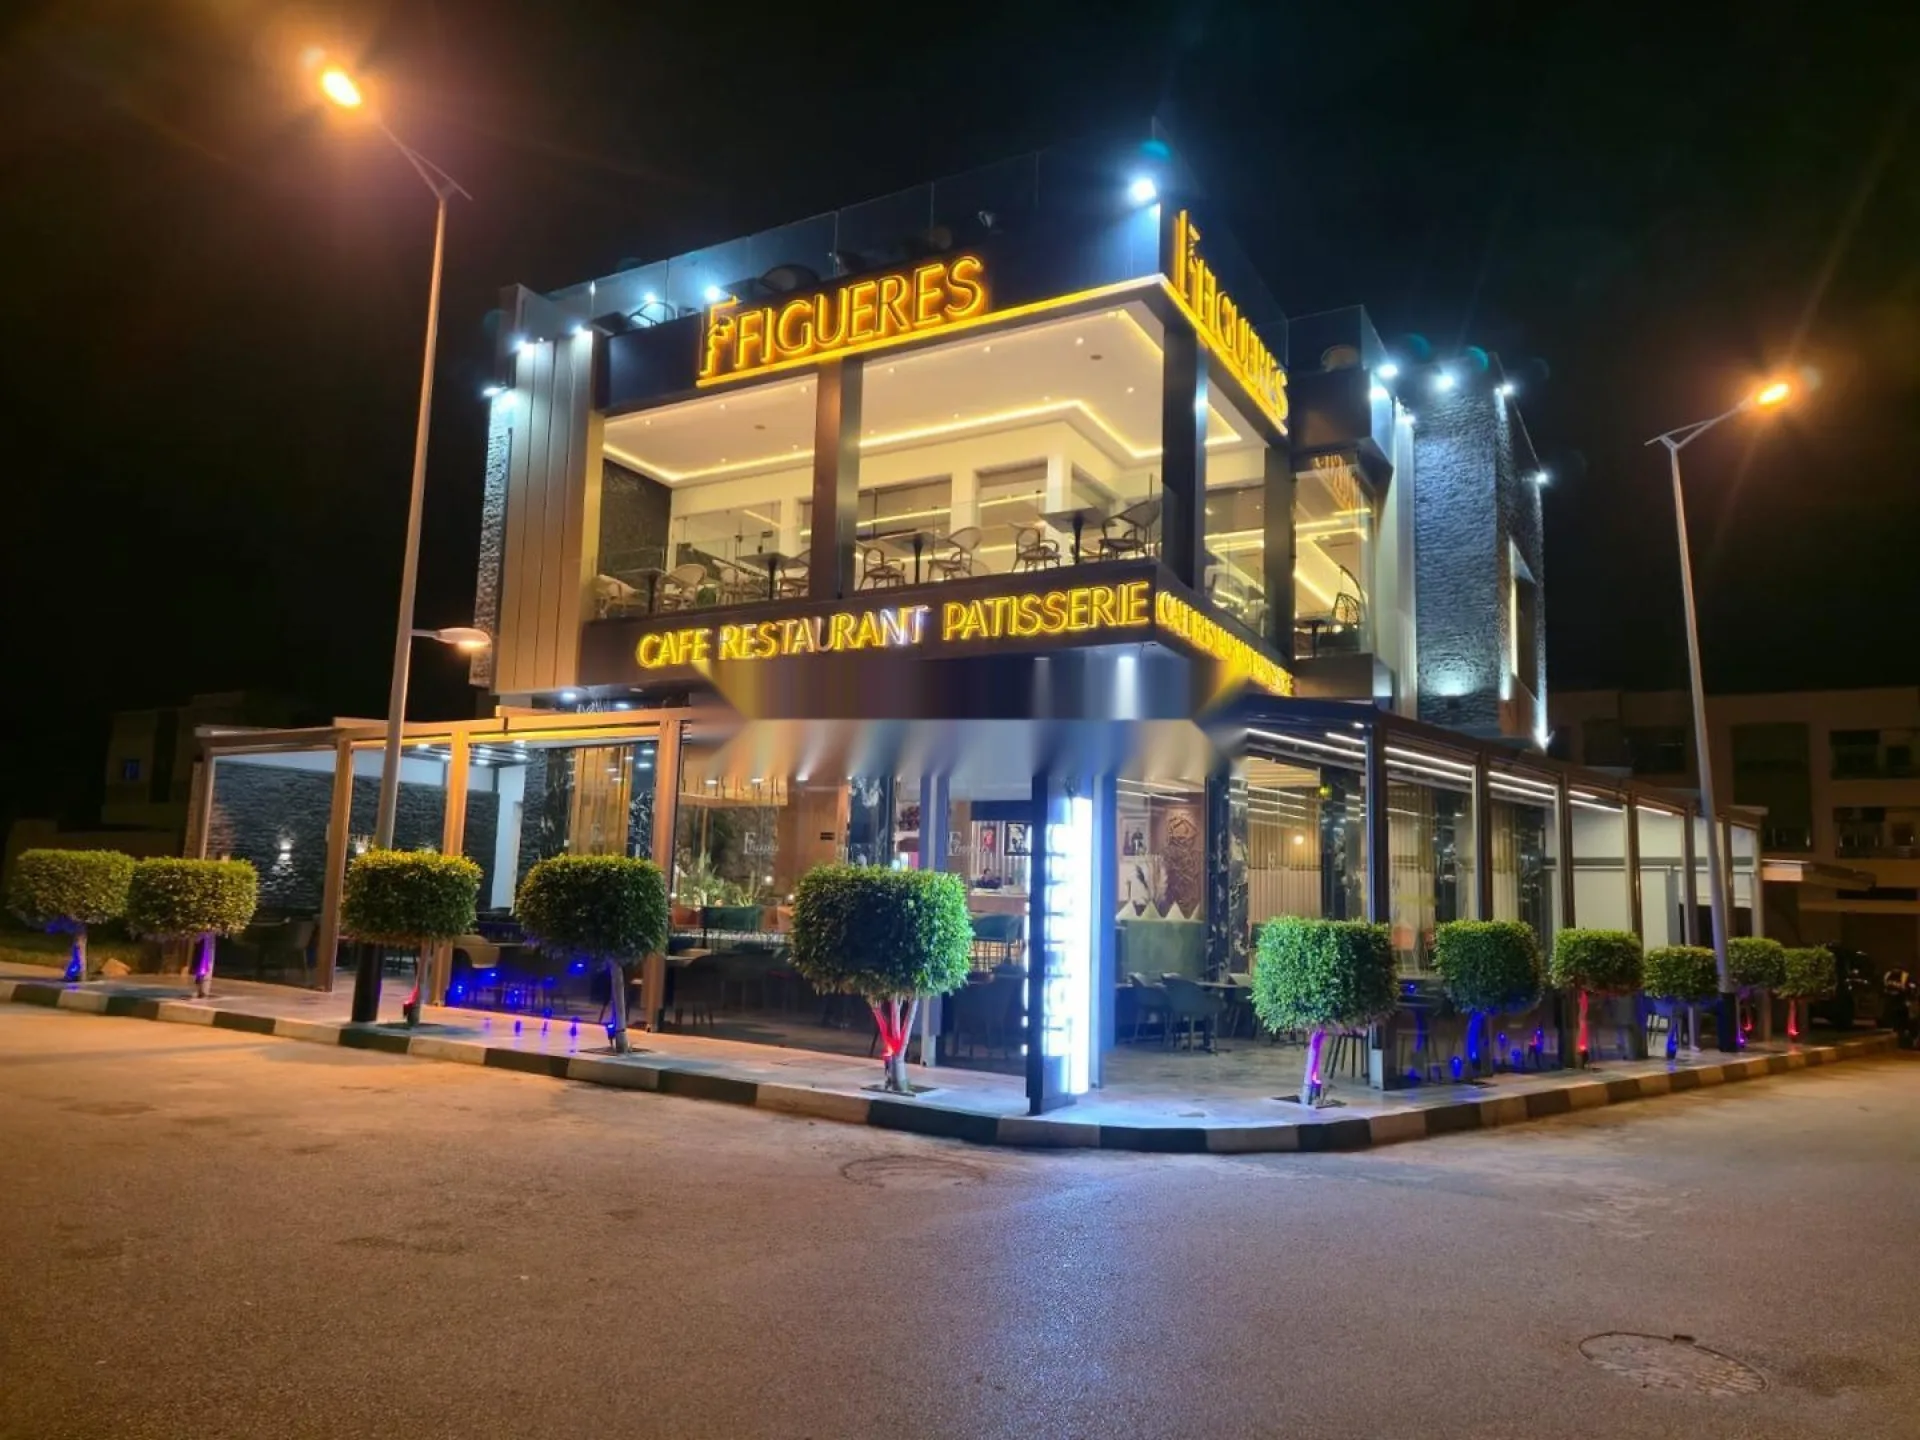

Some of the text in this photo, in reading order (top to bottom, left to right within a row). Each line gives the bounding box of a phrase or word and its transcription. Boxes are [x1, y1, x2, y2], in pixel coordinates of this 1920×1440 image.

[733, 255, 983, 368] FIGUERES
[637, 580, 1150, 669] CAFE RESTAURANT PATISSERIE
